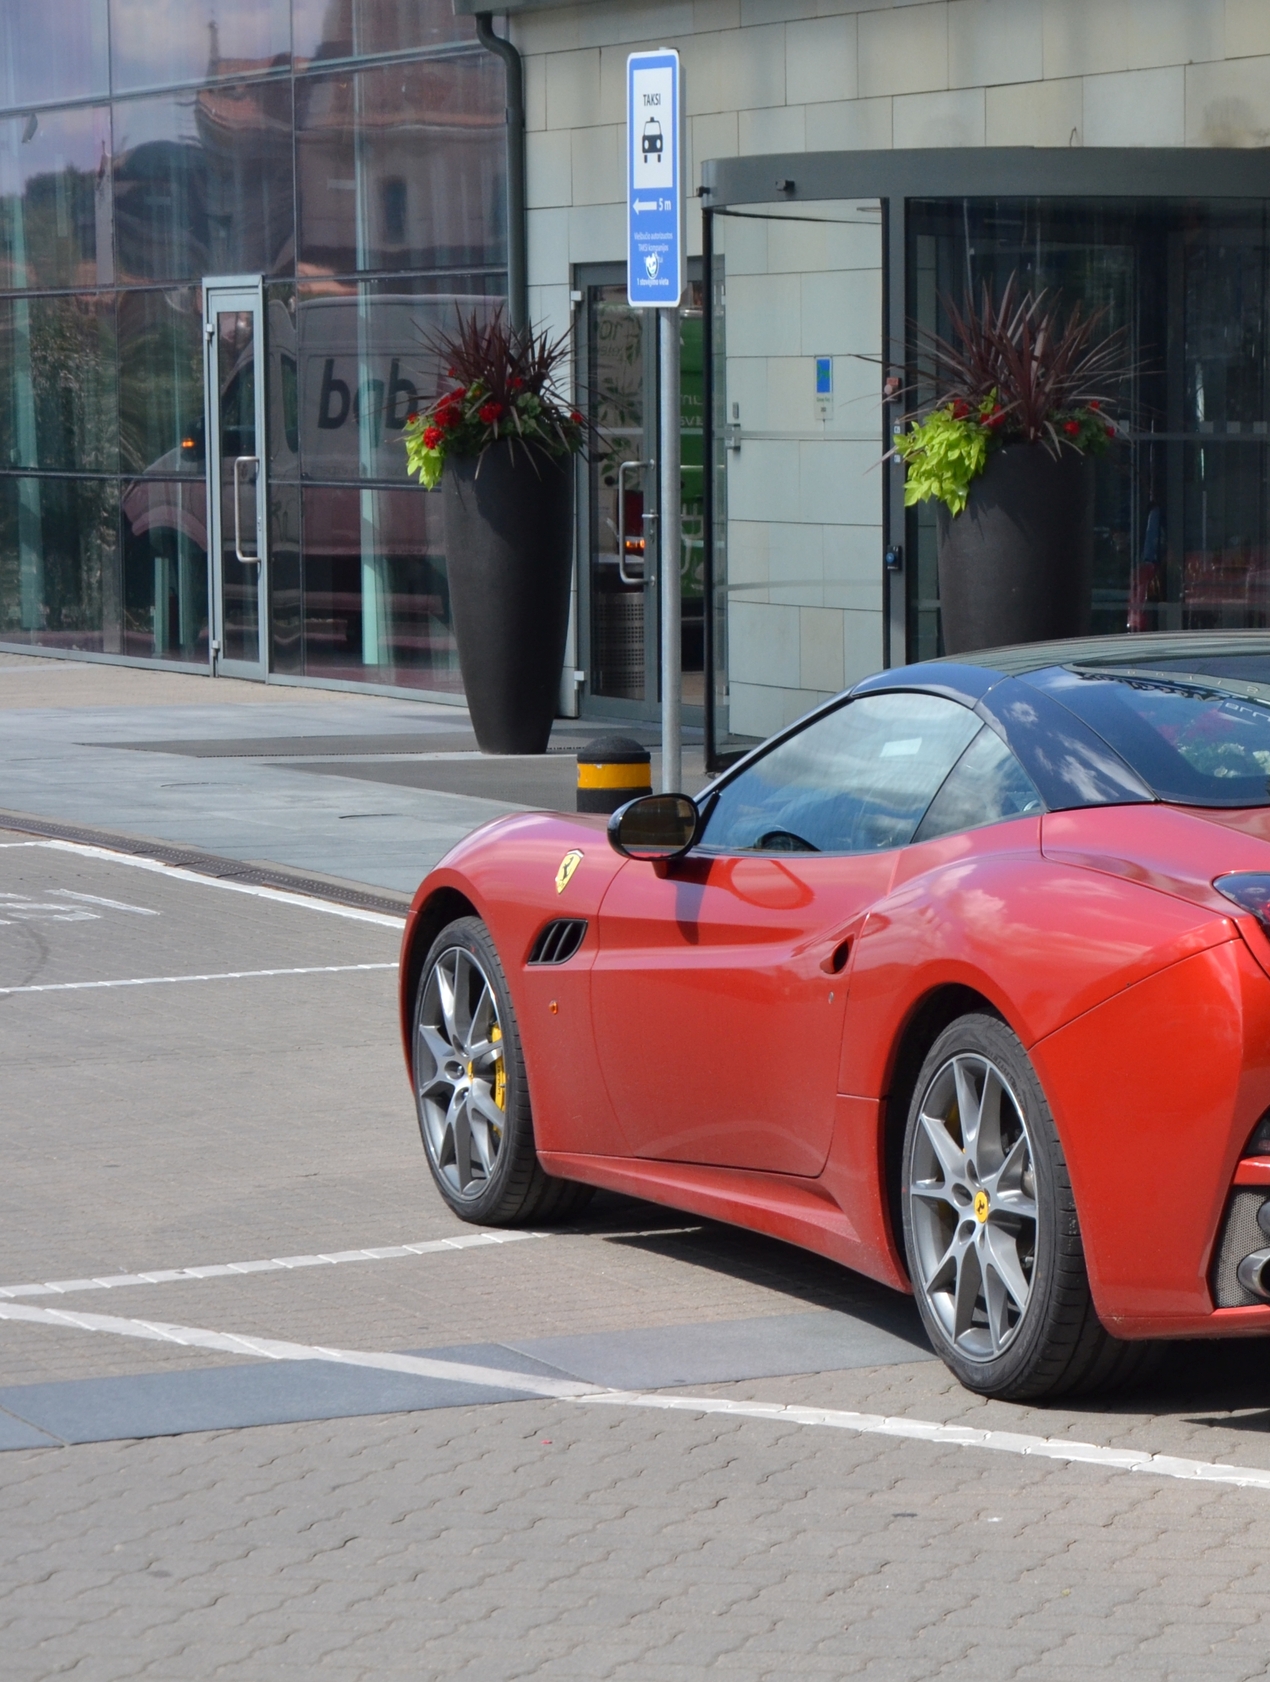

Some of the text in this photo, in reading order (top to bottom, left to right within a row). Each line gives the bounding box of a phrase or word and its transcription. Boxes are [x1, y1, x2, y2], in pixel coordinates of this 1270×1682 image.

[643, 93, 661, 106] TAKSI
[659, 198, 672, 211] 5 m
